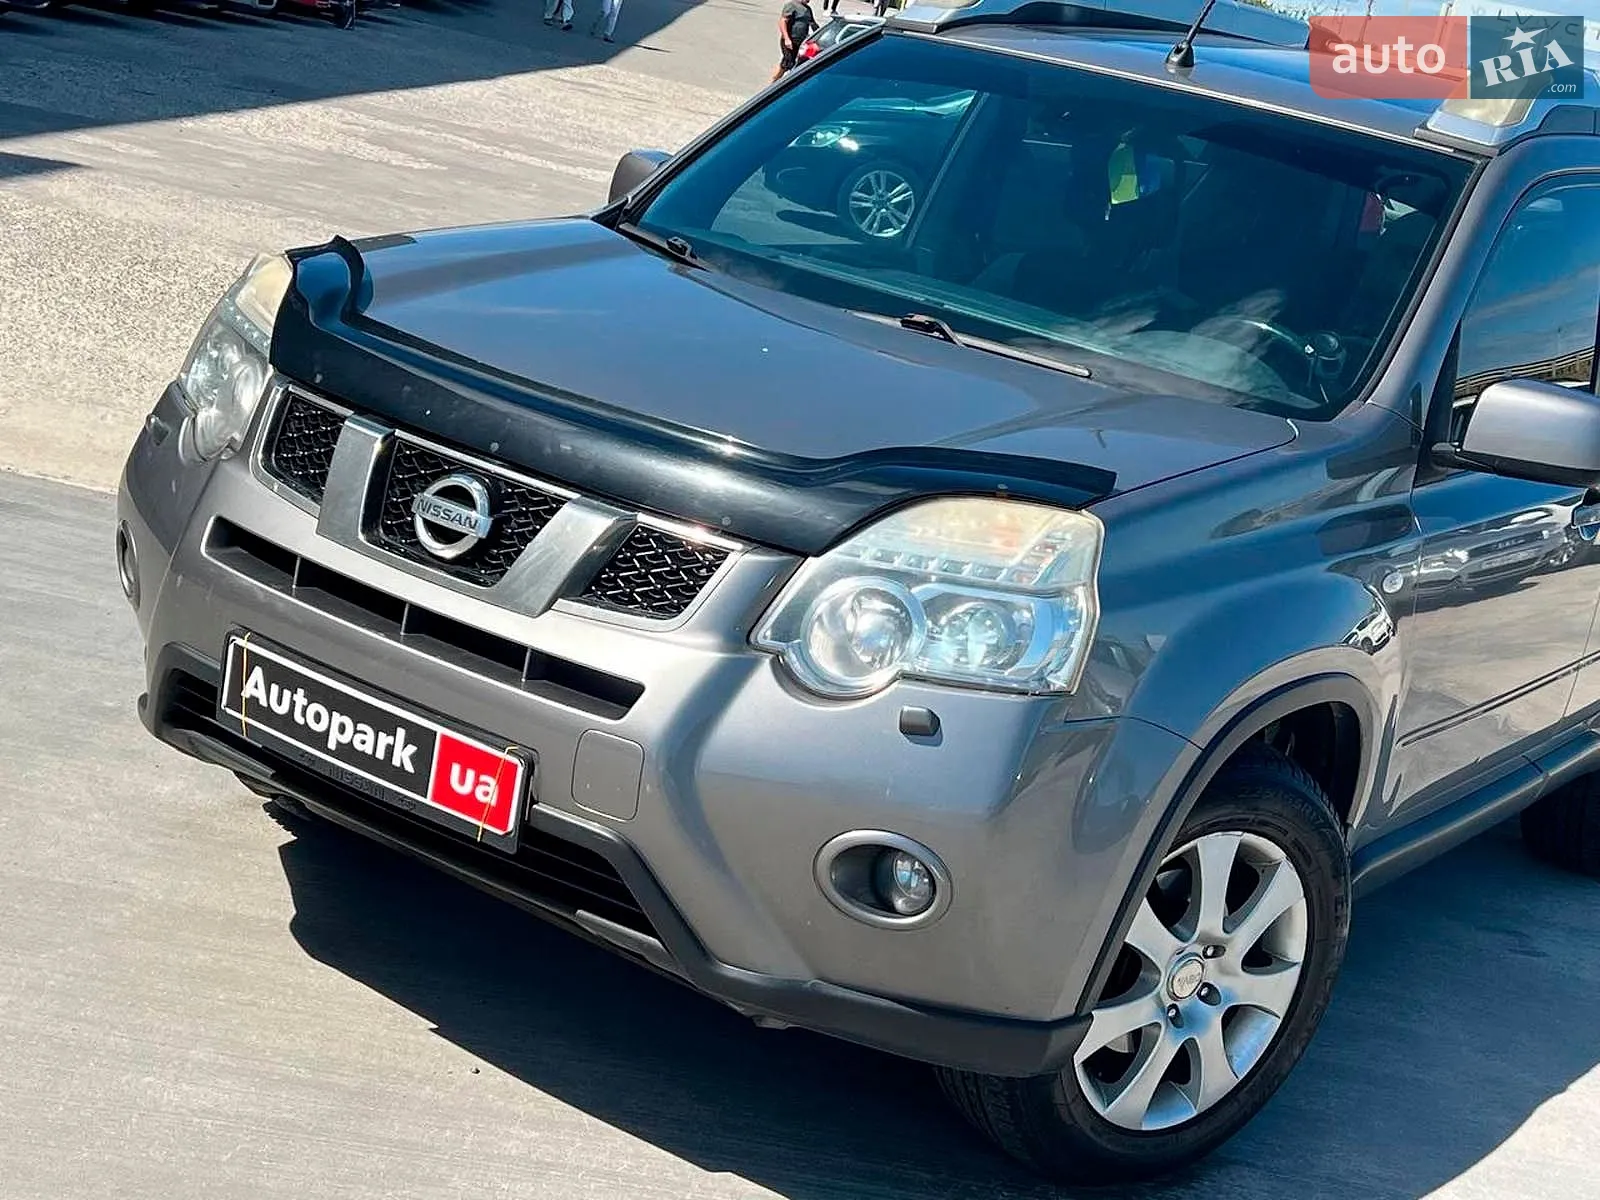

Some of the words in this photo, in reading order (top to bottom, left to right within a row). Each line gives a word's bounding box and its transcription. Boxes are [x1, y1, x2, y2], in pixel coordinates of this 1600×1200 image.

[417, 499, 478, 529] NISSAN
[242, 664, 419, 774] Autopark
[449, 761, 499, 807] ua
